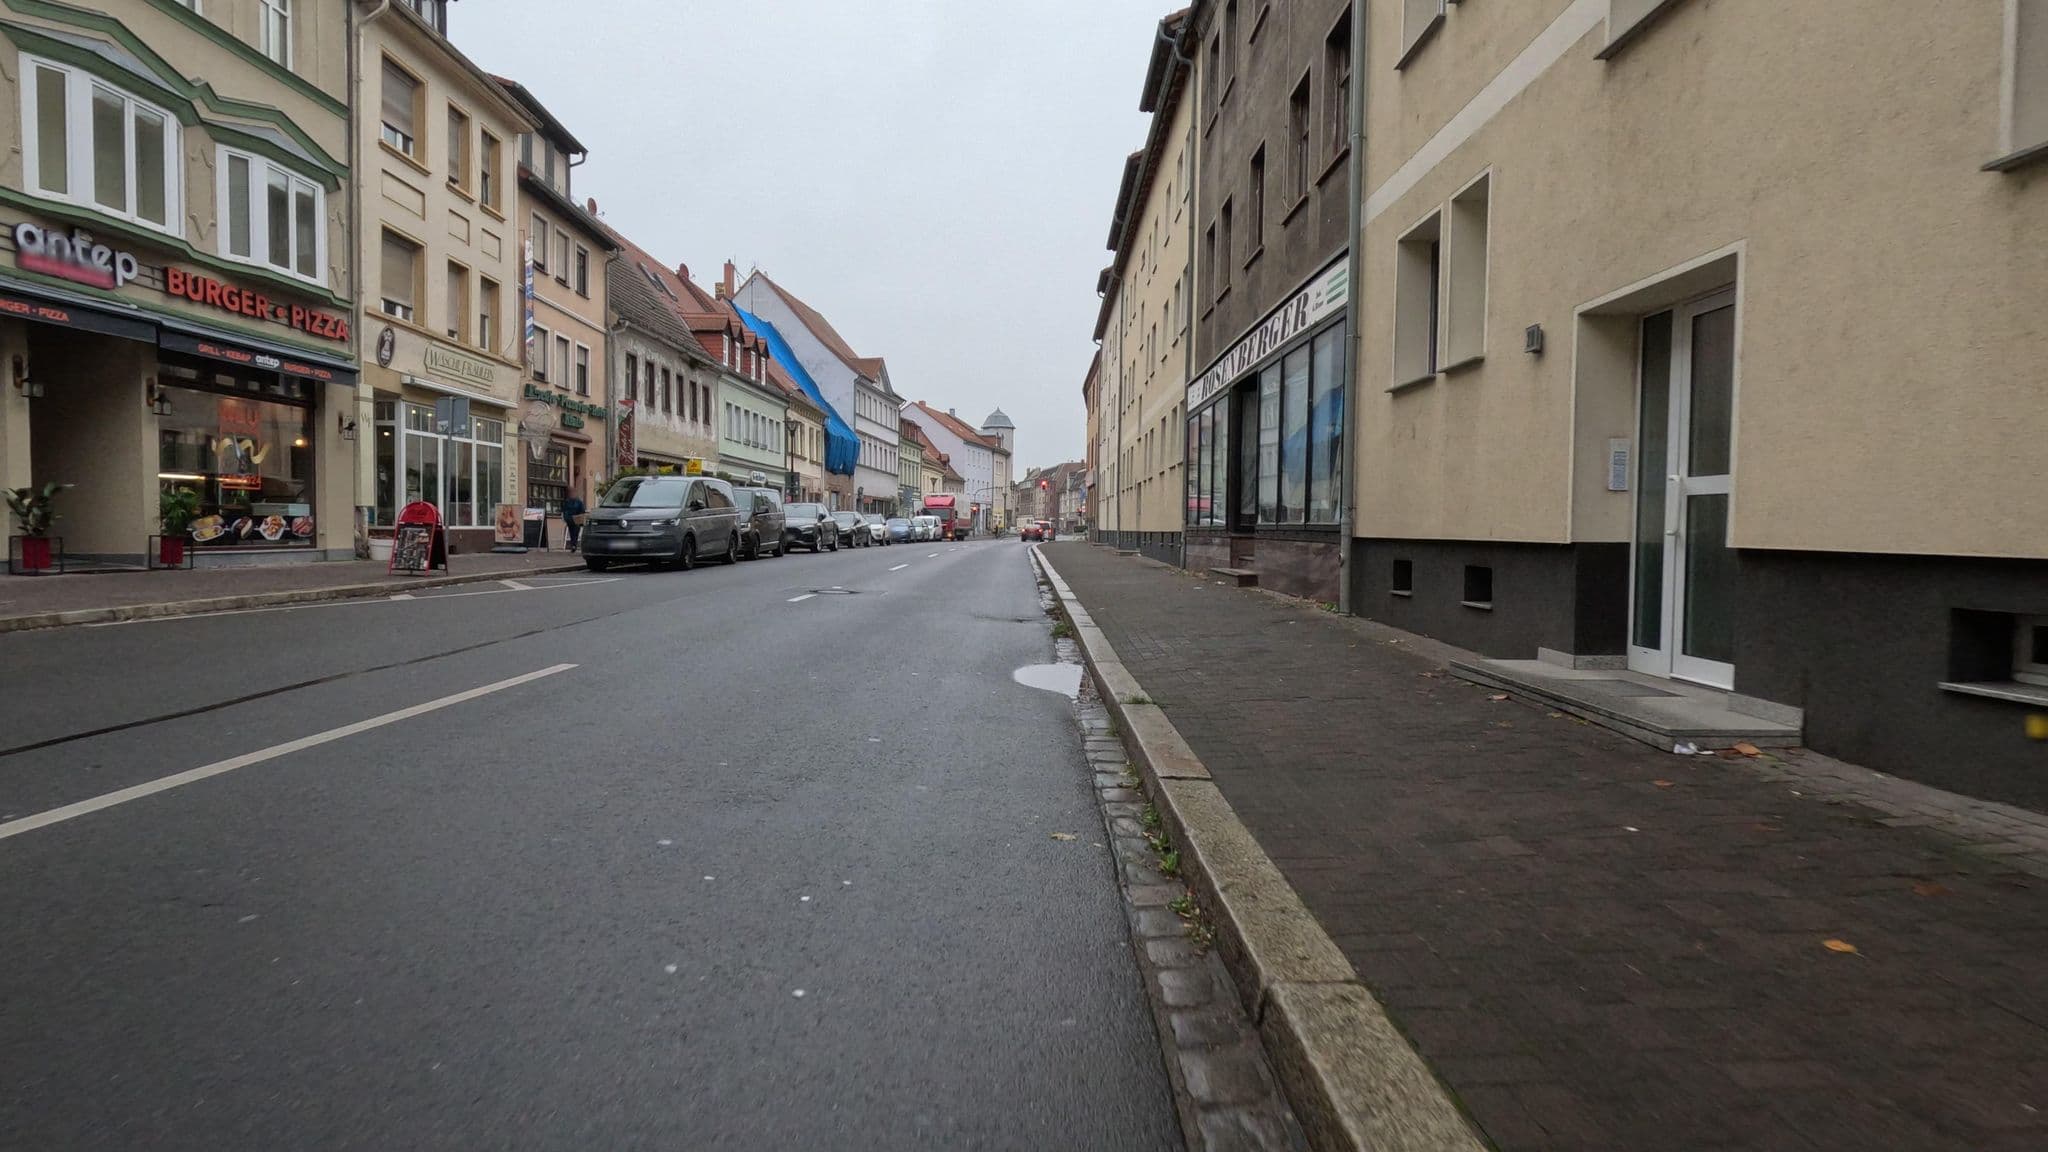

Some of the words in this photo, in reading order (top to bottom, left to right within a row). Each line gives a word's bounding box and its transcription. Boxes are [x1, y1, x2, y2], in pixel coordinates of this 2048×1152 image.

[16, 223, 138, 287] antep
[38, 307, 70, 322] PIZZA
[167, 267, 269, 320] BURGER
[290, 304, 348, 341] PIZZA
[197, 343, 221, 356] GRILL
[255, 355, 280, 368] antep
[1201, 292, 1309, 400] ROSENBERGER
